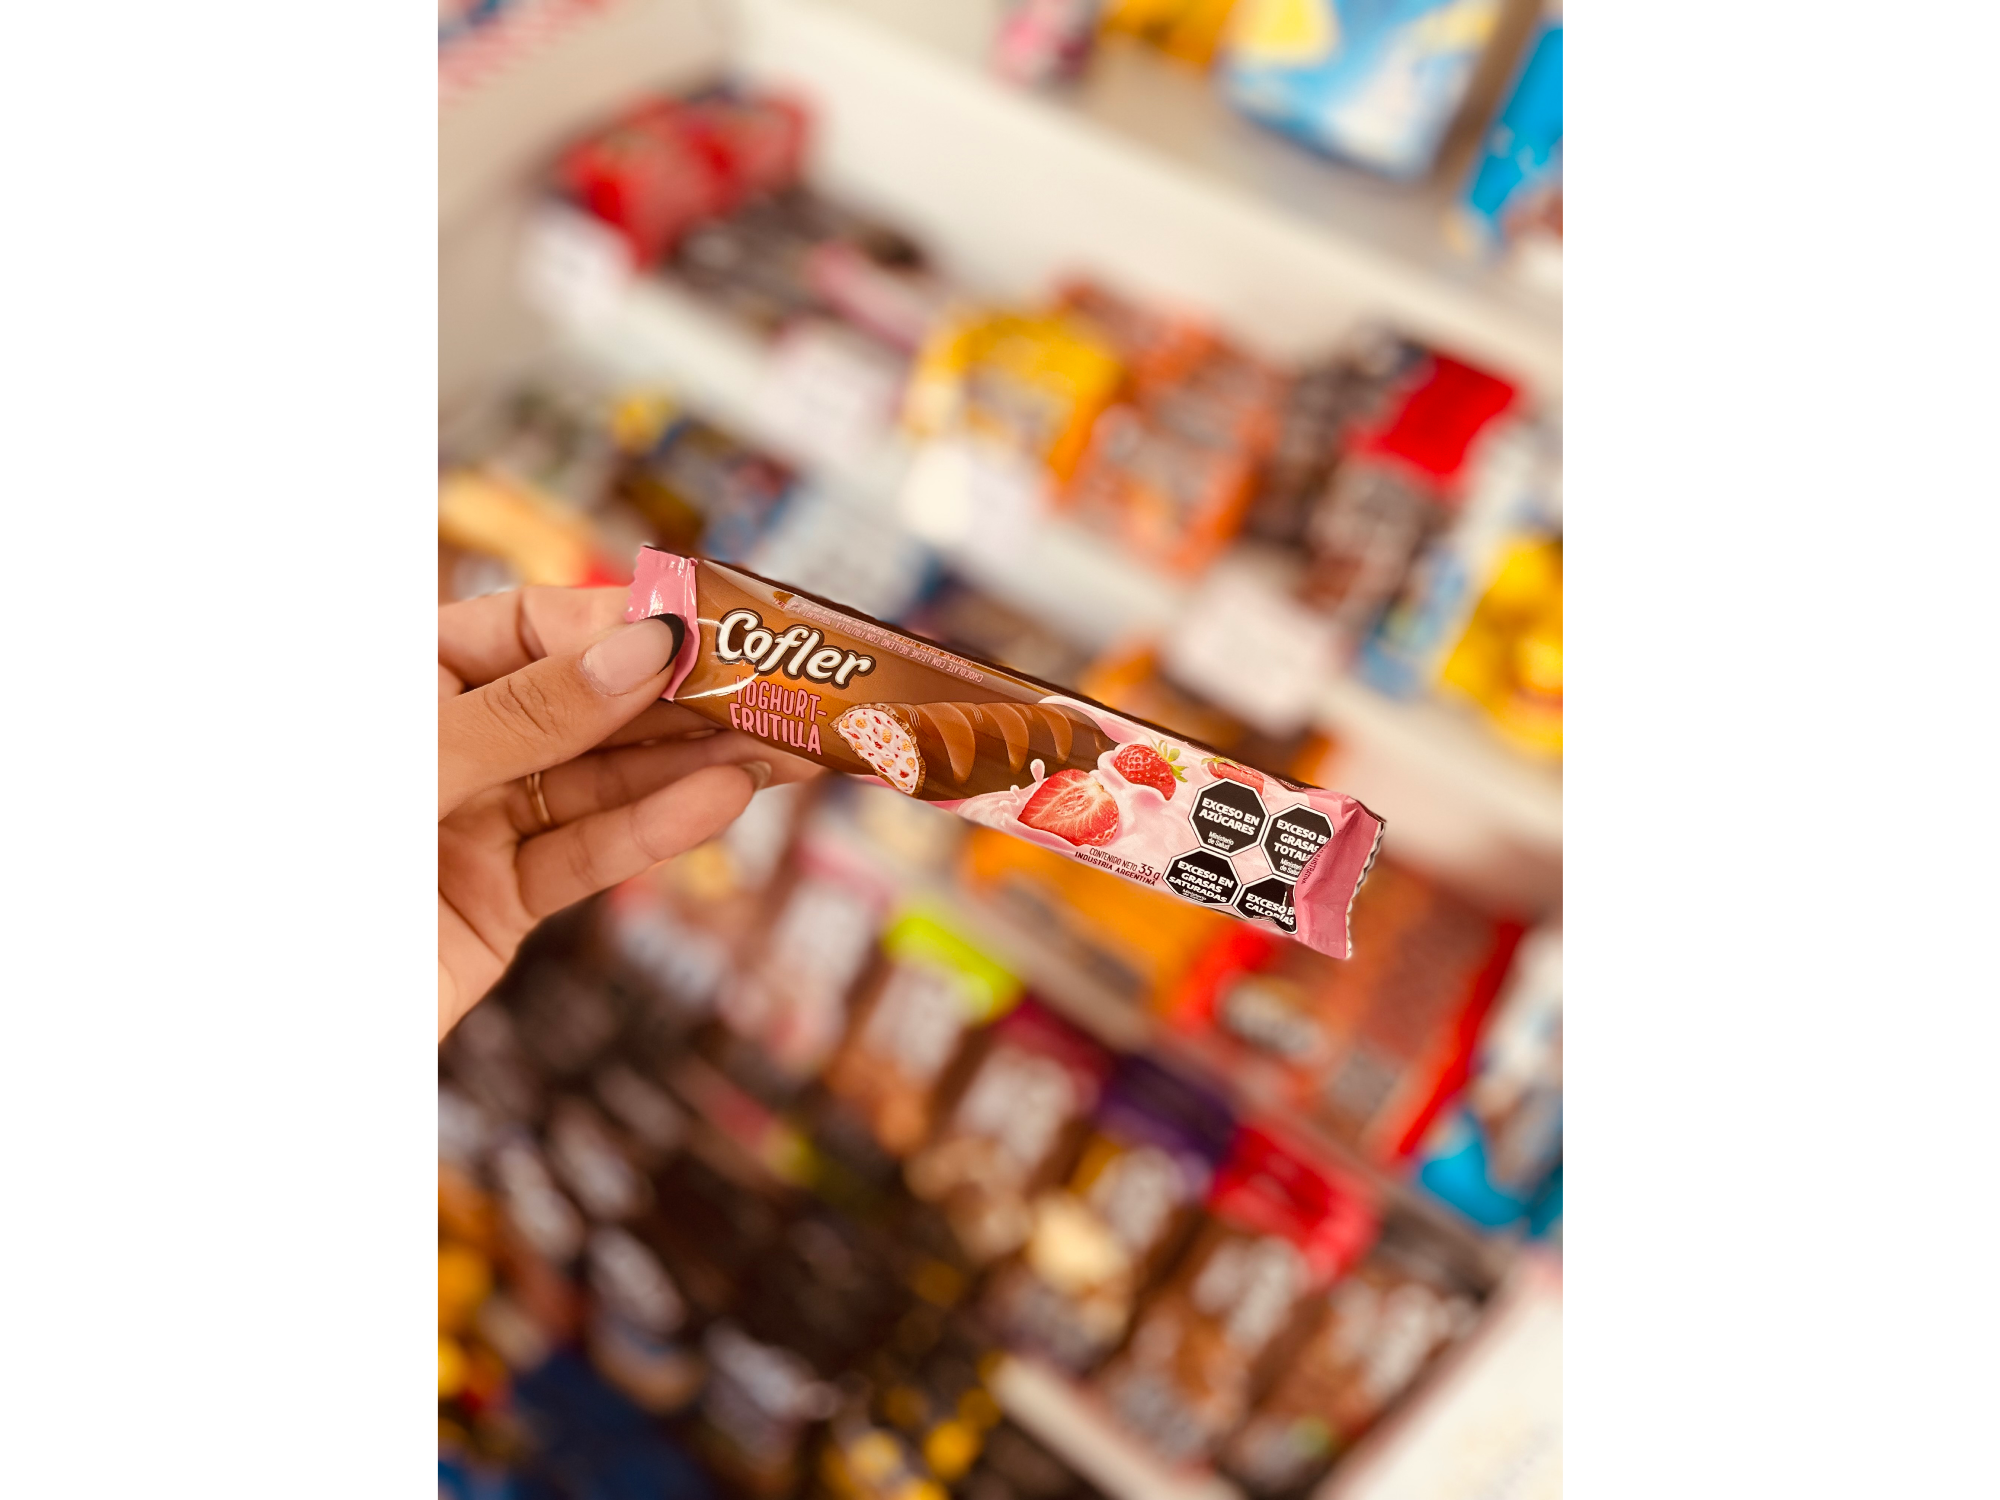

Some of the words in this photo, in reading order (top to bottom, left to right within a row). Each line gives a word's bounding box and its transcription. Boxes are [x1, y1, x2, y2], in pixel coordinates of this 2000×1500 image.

[802, 610, 831, 626] YOGHURT
[835, 622, 865, 639] FRUTILLA
[865, 633, 880, 645] CON
[717, 608, 876, 689] Cofler
[881, 638, 909, 655] RELLENO
[910, 649, 931, 664] LECHE
[931, 657, 946, 668] CON
[946, 662, 984, 683] CHOCOLATE
[729, 702, 822, 755] FRUTILLA
[1199, 807, 1255, 836] AZÚCARES
[1202, 797, 1242, 820] EXCESO
[1244, 812, 1260, 826] EN
[1208, 831, 1234, 846] Ministerio
[1276, 819, 1316, 841] EXCESO
[1215, 839, 1230, 850] Salud
[1075, 851, 1113, 870] INDUSTRIA
[1115, 867, 1155, 886] ARGENTINA
[1089, 848, 1121, 865] CONTENIDO
[1121, 860, 1137, 871] NETO
[1138, 863, 1154, 876] 35
[1153, 872, 1161, 880] g
[1177, 860, 1218, 881] EXCESO
[1218, 874, 1234, 888] EN
[1280, 864, 1288, 872] de
[1168, 876, 1227, 903] SATURADAS
[1181, 871, 1222, 893] GRASAS
[1246, 892, 1286, 914] EXCESO
